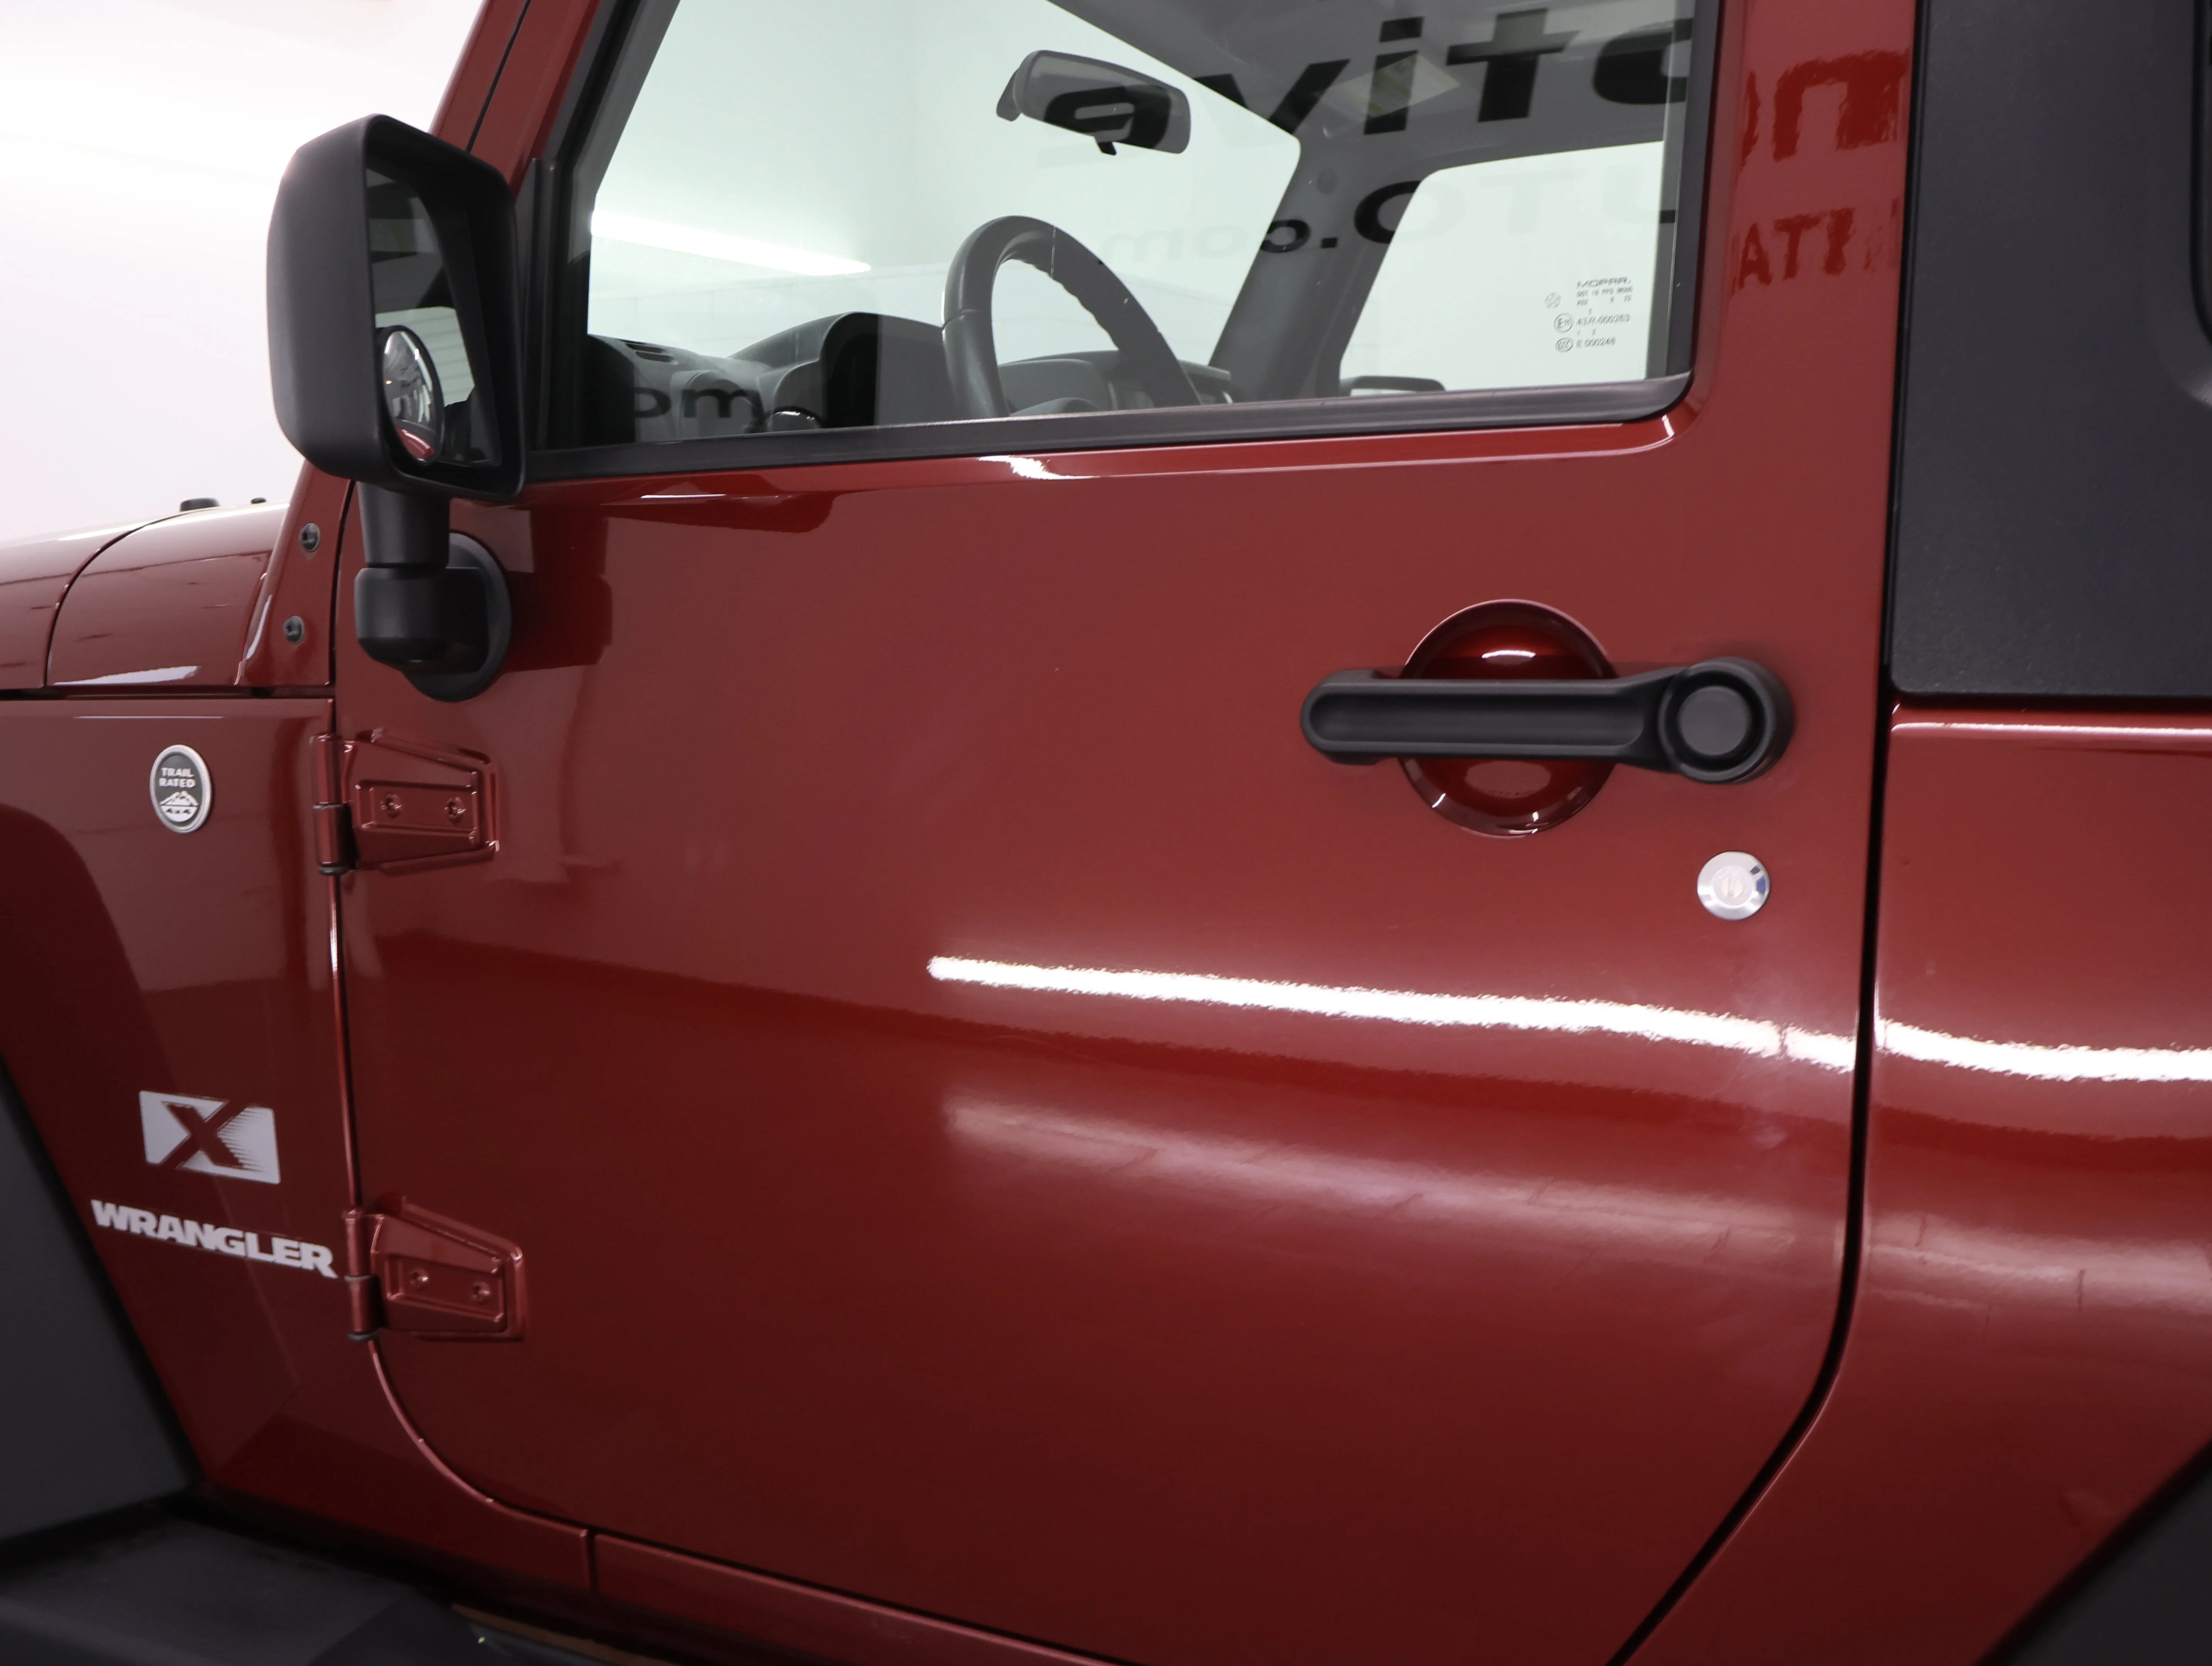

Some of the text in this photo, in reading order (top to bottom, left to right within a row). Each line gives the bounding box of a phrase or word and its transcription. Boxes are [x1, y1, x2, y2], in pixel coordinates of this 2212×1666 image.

[161, 767, 194, 777] TRAIL
[159, 777, 196, 788] RATED
[90, 1199, 339, 1279] WRANGLER
